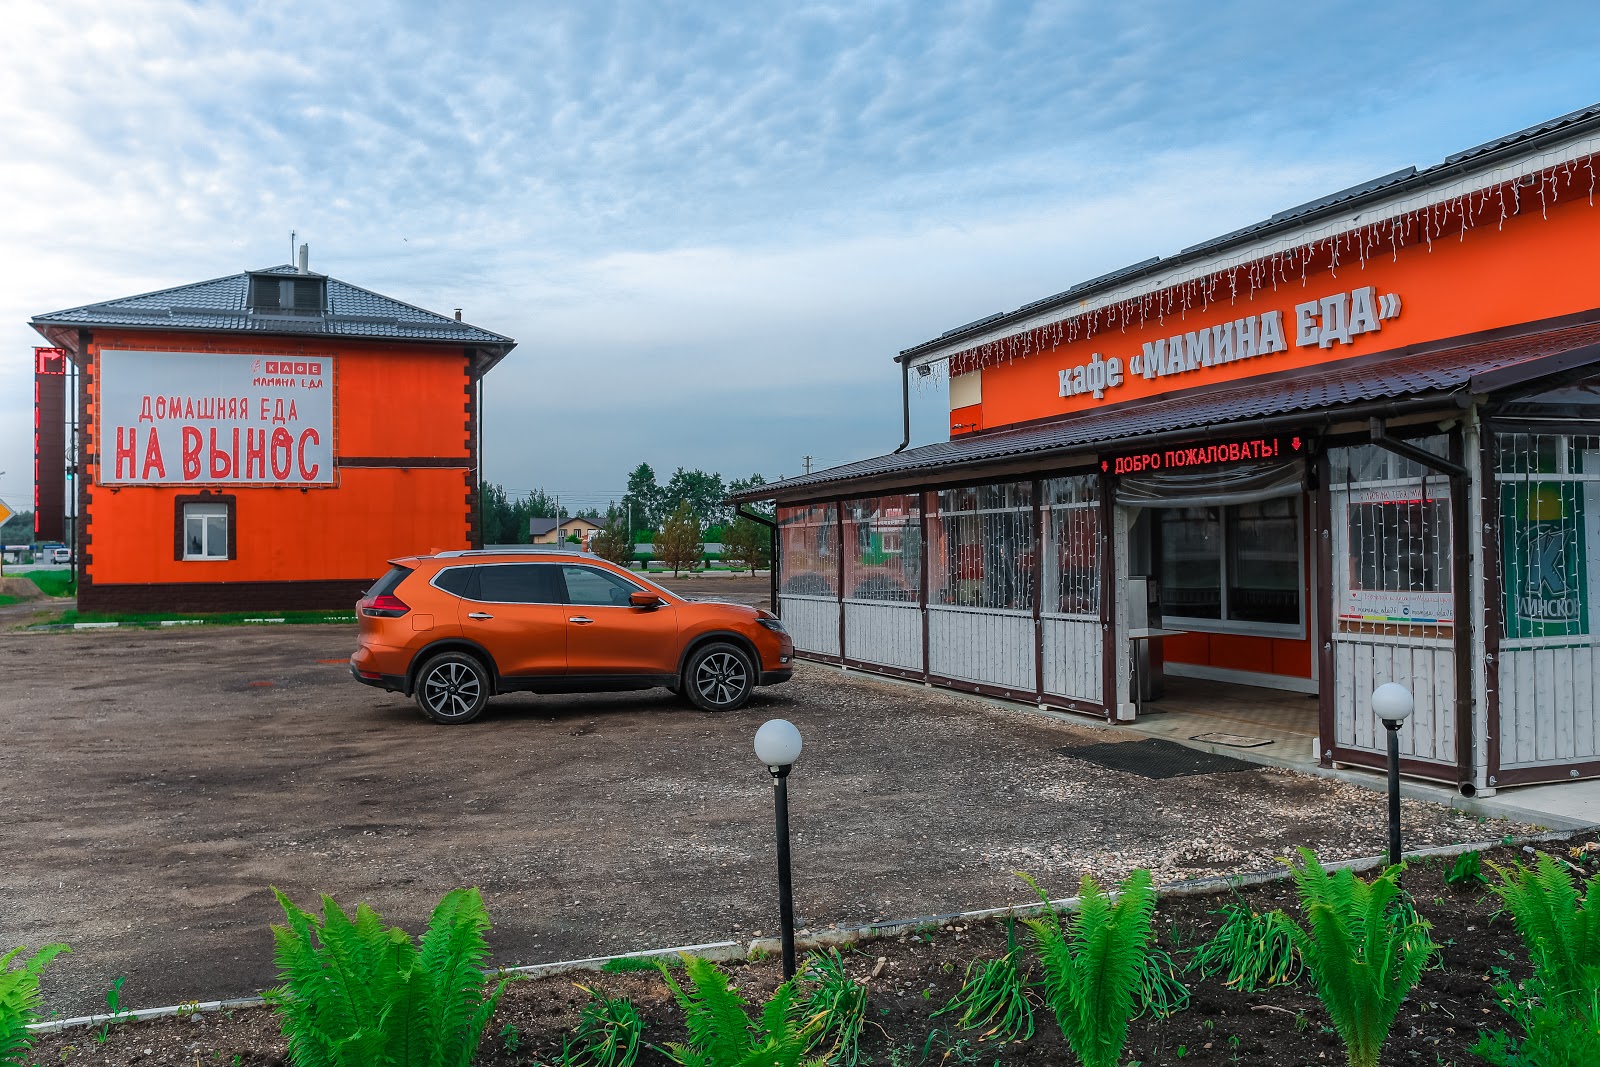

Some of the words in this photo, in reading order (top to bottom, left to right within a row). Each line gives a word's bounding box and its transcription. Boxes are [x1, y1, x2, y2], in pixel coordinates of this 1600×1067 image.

[1058, 353, 1124, 399] кафе
[1130, 310, 1288, 380] «МАМИНА
[1295, 286, 1402, 349] ЕДА»
[253, 377, 296, 388] МАМИНА
[301, 378, 323, 390] ЕДА
[266, 362, 320, 374] КАФЕ
[138, 395, 249, 423] ДОМАШНЯЯ
[260, 397, 298, 425] ЕДА
[115, 426, 166, 480] НА
[182, 425, 321, 481] ВЫНОС
[1114, 453, 1161, 475] ДОБРО
[1165, 438, 1279, 468] ПОЖАЛОВАТЬ!
